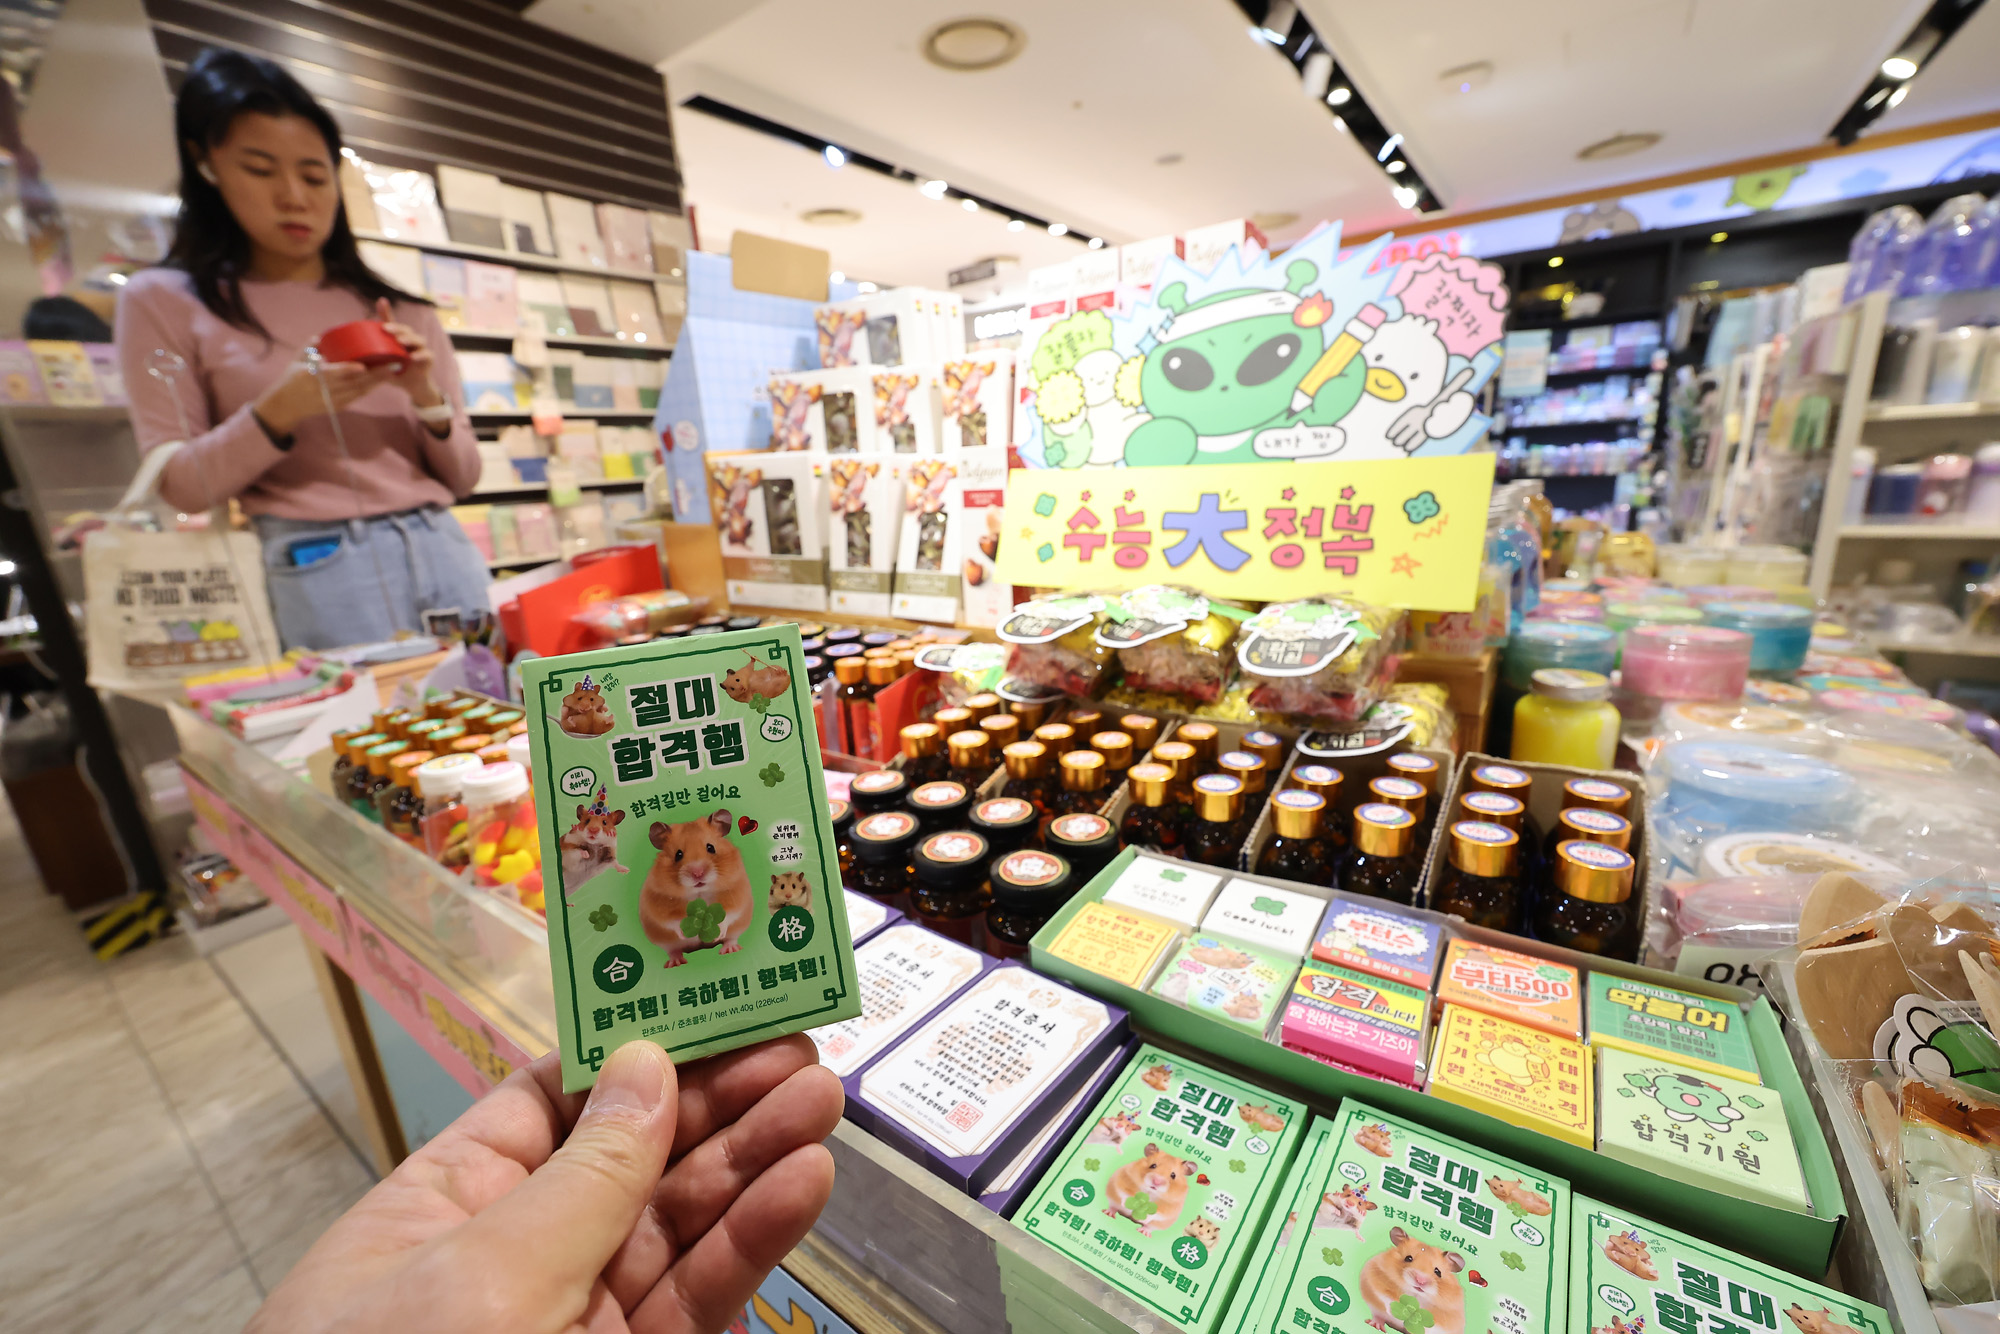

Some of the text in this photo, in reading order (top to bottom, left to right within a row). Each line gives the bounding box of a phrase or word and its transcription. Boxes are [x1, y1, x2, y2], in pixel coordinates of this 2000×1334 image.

[1064, 506, 1151, 568] 수능
[1263, 504, 1374, 576] 정복
[117, 584, 238, 605] NO FOOD WASTE
[630, 677, 716, 727] 절대
[612, 722, 745, 782] 합격햄
[630, 784, 741, 819] 합격길만 걸어요
[777, 916, 806, 942] 格
[1223, 911, 1294, 936] Good luck!
[602, 956, 634, 984] 合
[1453, 965, 1569, 997] 부터500
[593, 993, 669, 1032] 합격햄!
[678, 974, 749, 1008] 축하햄!
[757, 955, 828, 990] 행복햄!
[1311, 975, 1379, 1009] 합격
[677, 1015, 707, 1031] 준초콜릿
[715, 1009, 728, 1019] Net
[756, 993, 788, 1009] (226Kcal)
[994, 999, 1056, 1034] 합격증서
[1179, 1081, 1234, 1117] 절대
[1150, 1097, 1235, 1148] 합격햄
[1145, 1127, 1212, 1164] 합격길만 걸어요
[1630, 1119, 1761, 1175] 합격기원
[1409, 1146, 1479, 1194] 절대
[1070, 1186, 1089, 1201] 合
[1381, 1165, 1494, 1236] 합격햄
[1044, 1201, 1200, 1298] 합격햄! 축하햄! 행복햄!
[1382, 1205, 1479, 1257] 합격길만 걸어요
[1177, 1242, 1200, 1264] 格
[1316, 1286, 1343, 1307] 合
[1677, 1262, 1777, 1330] 절대
